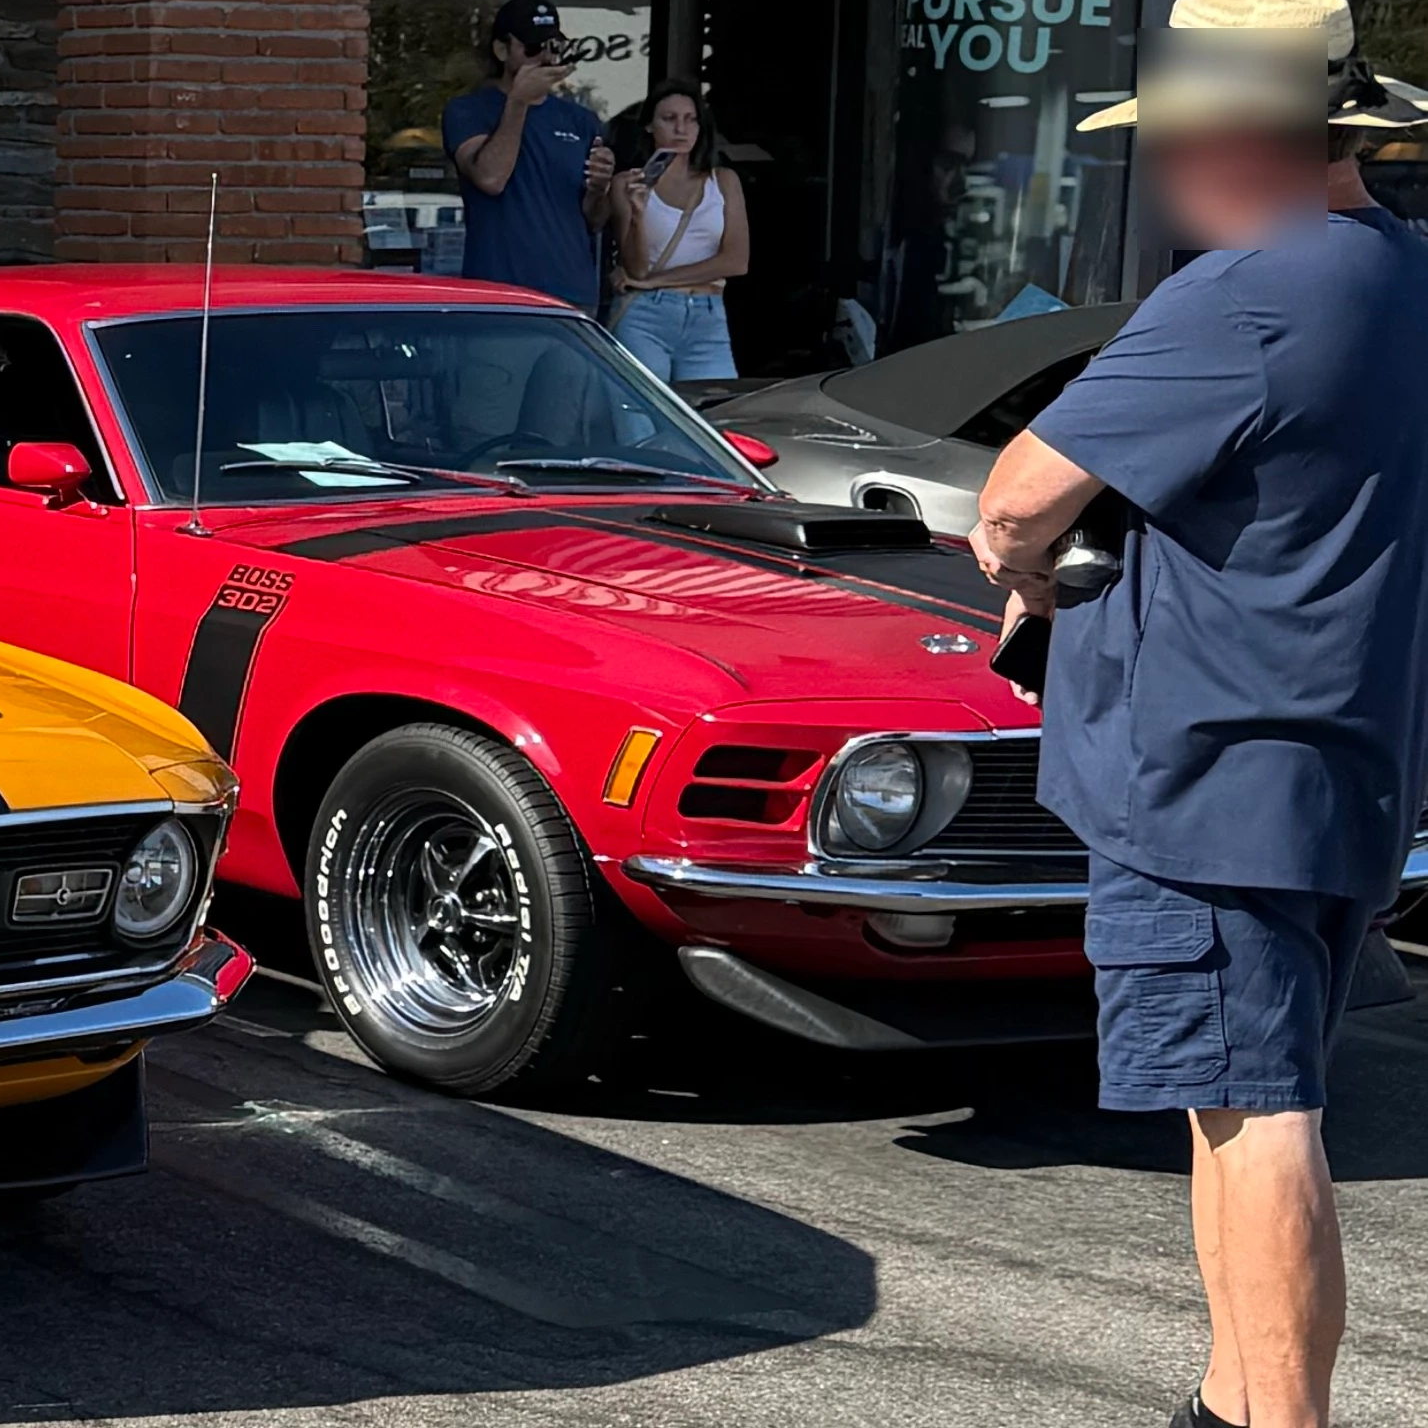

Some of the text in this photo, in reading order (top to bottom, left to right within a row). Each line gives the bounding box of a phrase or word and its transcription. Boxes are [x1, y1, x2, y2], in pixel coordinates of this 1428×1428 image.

[899, 23, 1051, 74] EAL YOU
[217, 588, 278, 614] 302
[227, 563, 296, 591] BOSS
[494, 822, 532, 943] Radial
[316, 809, 363, 1016] BFGoodrich
